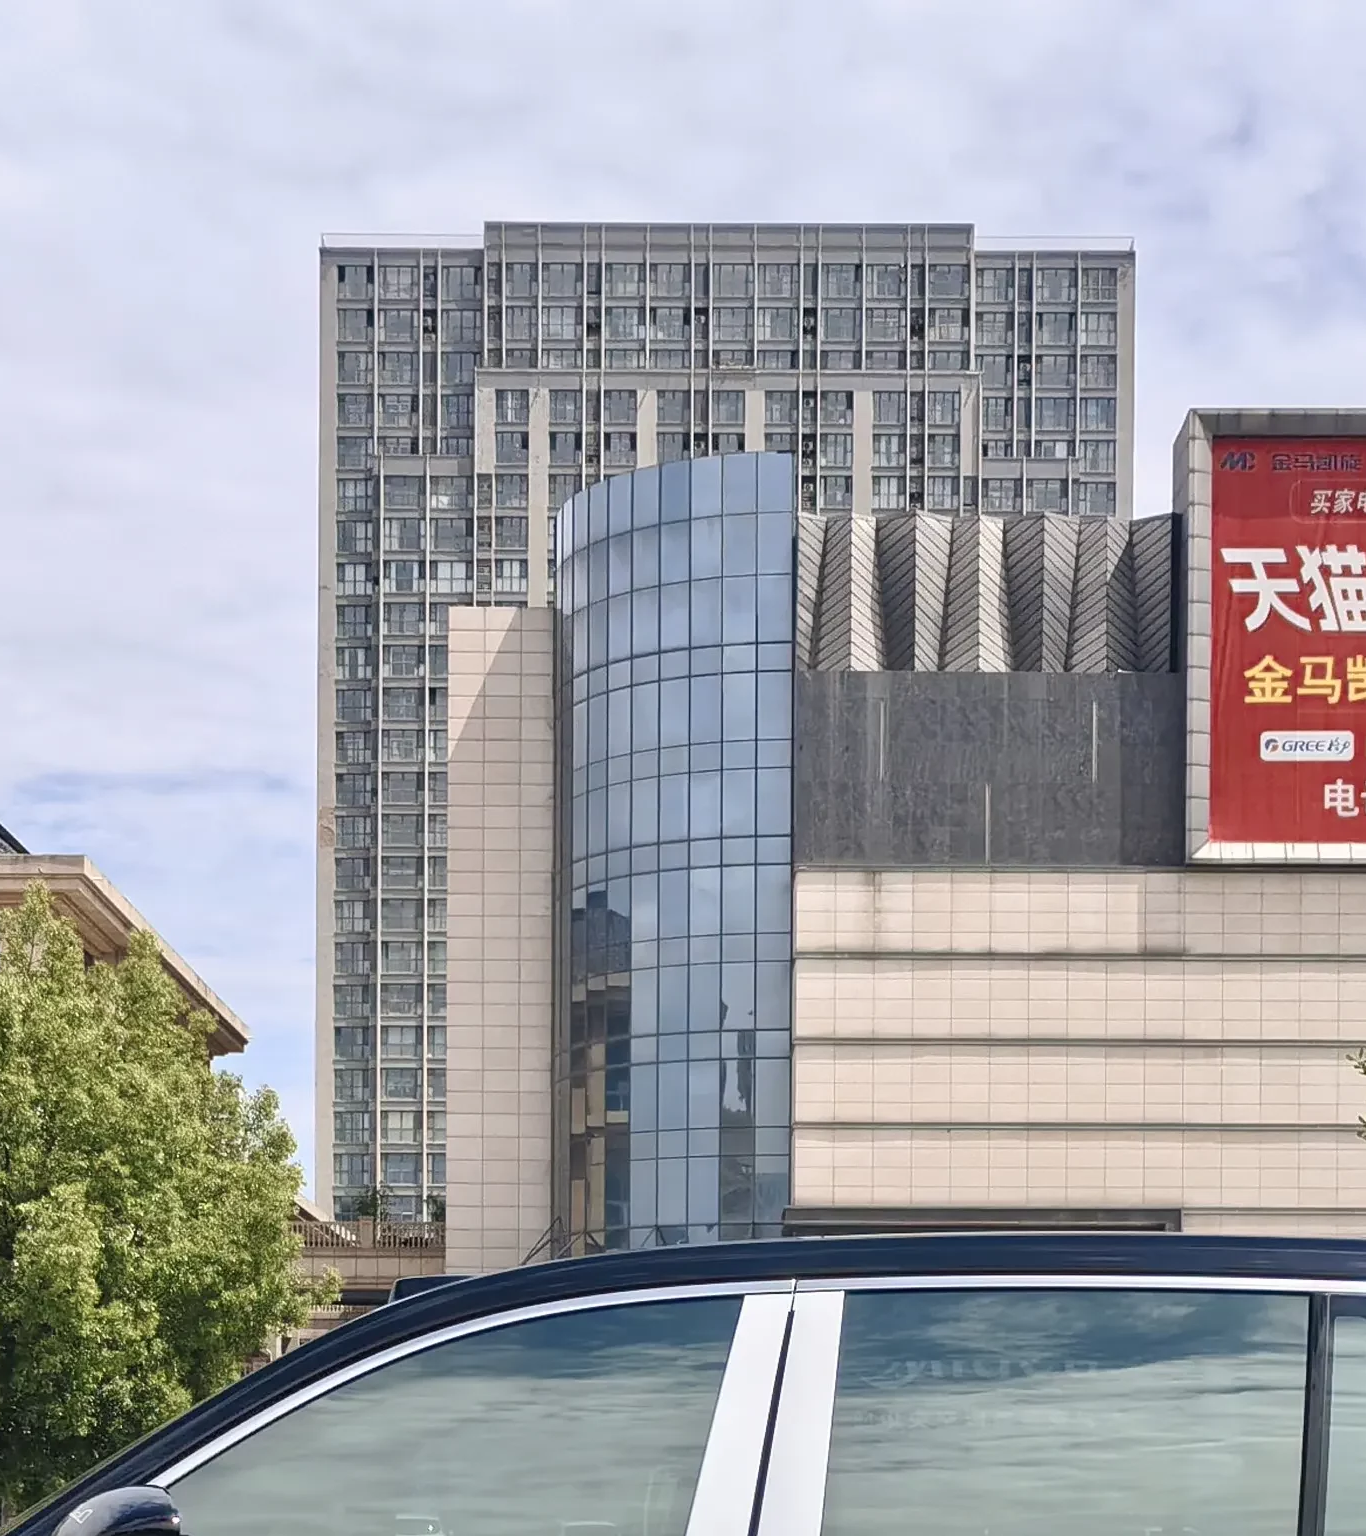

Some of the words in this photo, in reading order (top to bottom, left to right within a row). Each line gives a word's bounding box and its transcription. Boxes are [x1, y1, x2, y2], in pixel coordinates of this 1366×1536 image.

[1271, 453, 1363, 472] 金马凯旋
[1282, 740, 1327, 753] GREE
